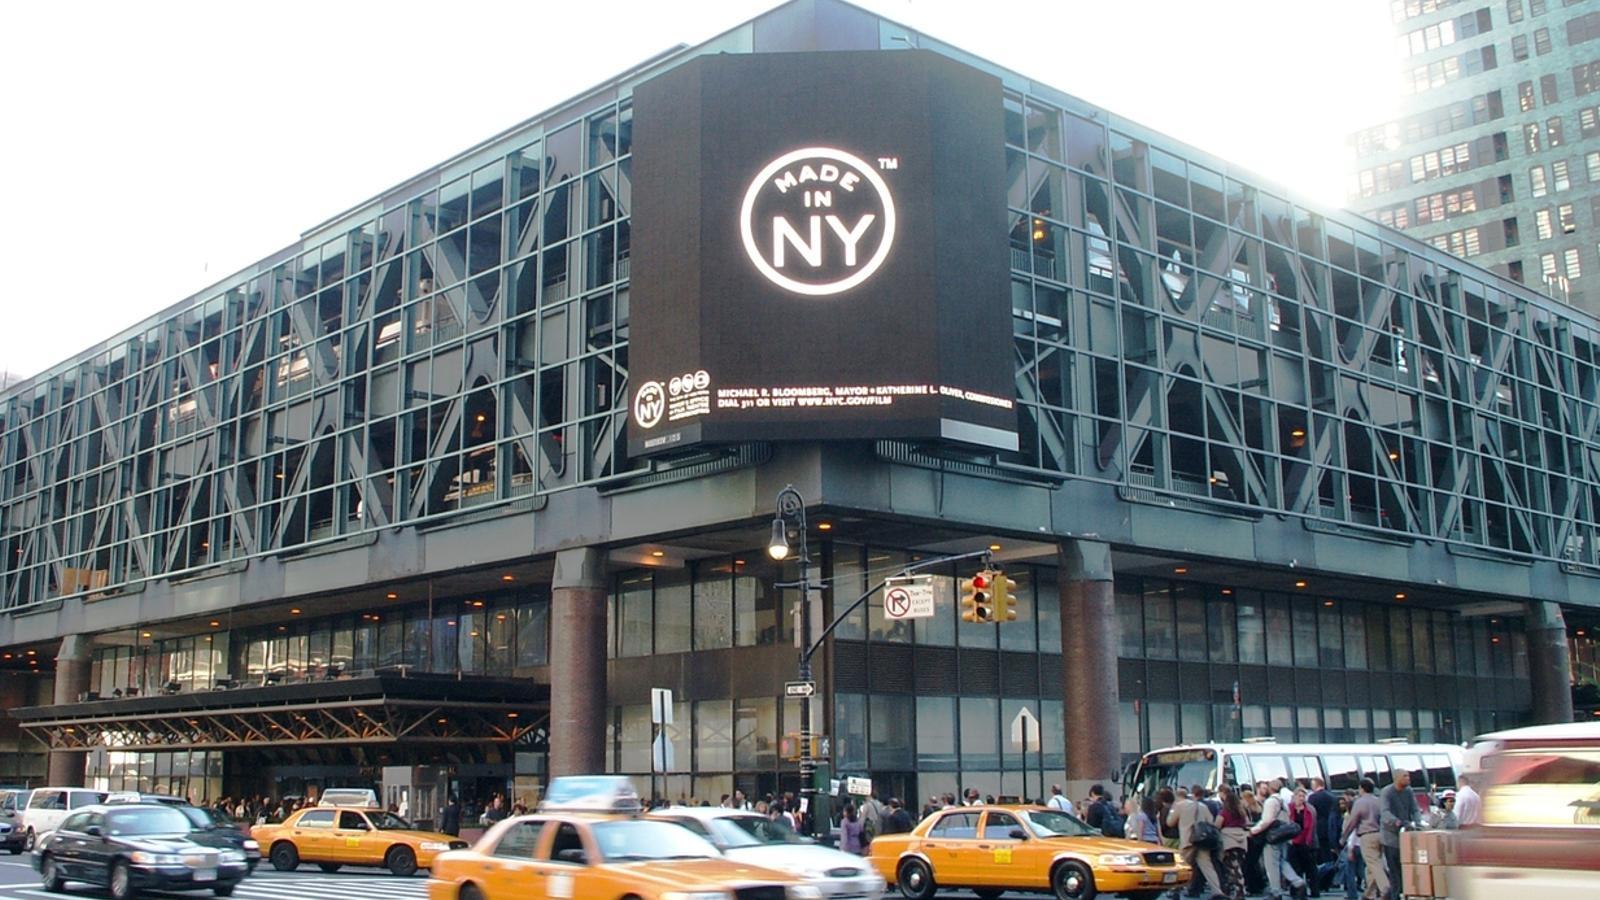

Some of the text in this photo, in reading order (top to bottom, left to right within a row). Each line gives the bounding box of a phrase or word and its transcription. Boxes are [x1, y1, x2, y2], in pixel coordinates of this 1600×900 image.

[877, 158, 899, 170] TM
[774, 164, 861, 194] MADE
[803, 190, 833, 208] IN
[772, 214, 876, 267] NY
[717, 388, 760, 398] MICHAEL
[761, 387, 771, 397] R.
[772, 386, 833, 397] BLOOMBERG,
[835, 386, 869, 396] MAYOR
[876, 385, 928, 395] KATHERINE
[929, 385, 939, 394] L.
[639, 399, 661, 420] NY
[717, 395, 893, 409] DIAL 311 OR VISIT WWW.NYC.GOV/FILM
